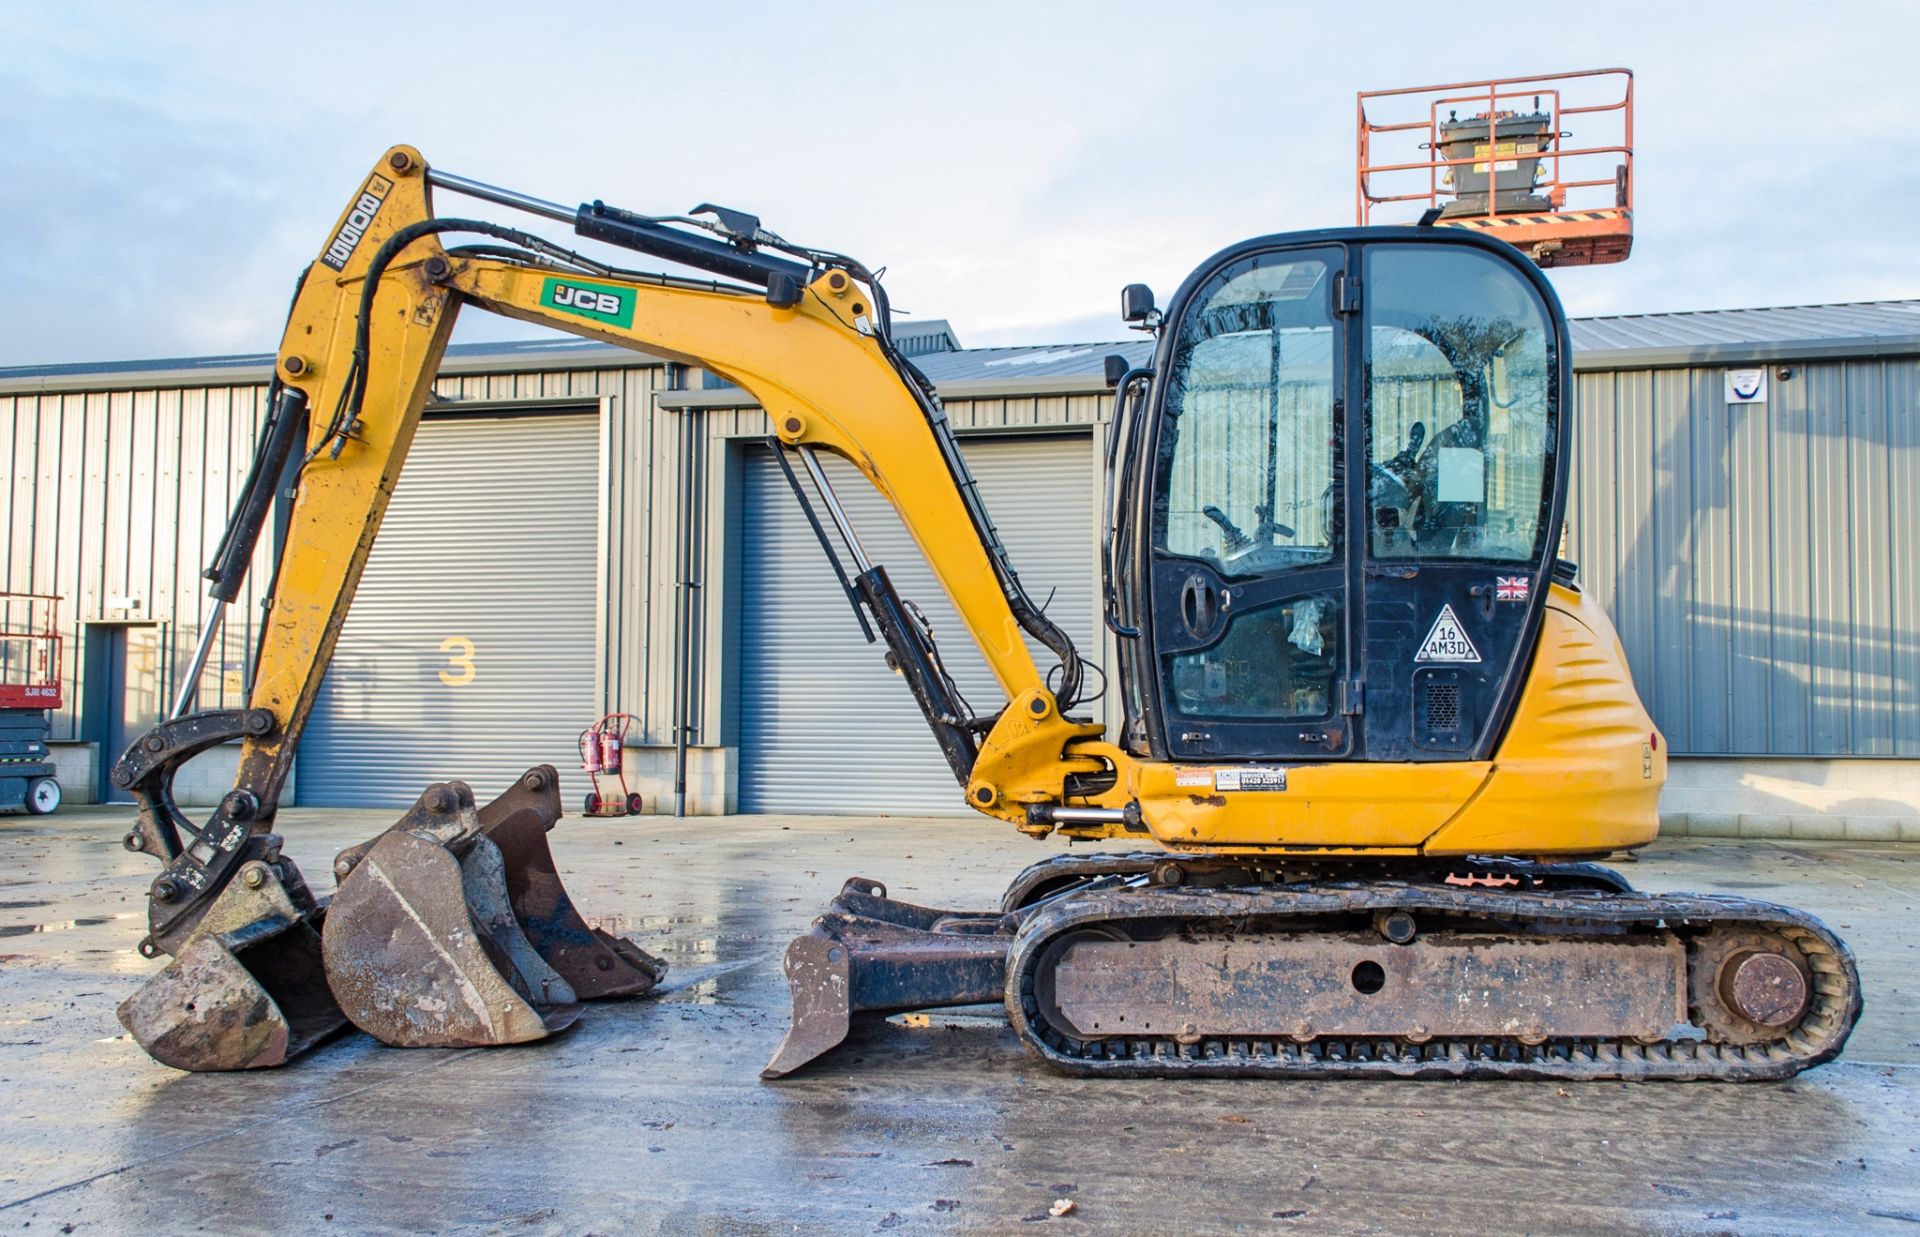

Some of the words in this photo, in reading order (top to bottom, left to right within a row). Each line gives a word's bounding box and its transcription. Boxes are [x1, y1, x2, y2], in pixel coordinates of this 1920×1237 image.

[328, 192, 381, 261] 8055
[554, 285, 620, 314] JCB
[1439, 627, 1456, 640] 16
[1430, 641, 1466, 655] AM3D
[438, 635, 476, 686] 3
[41, 688, 57, 697] 4632
